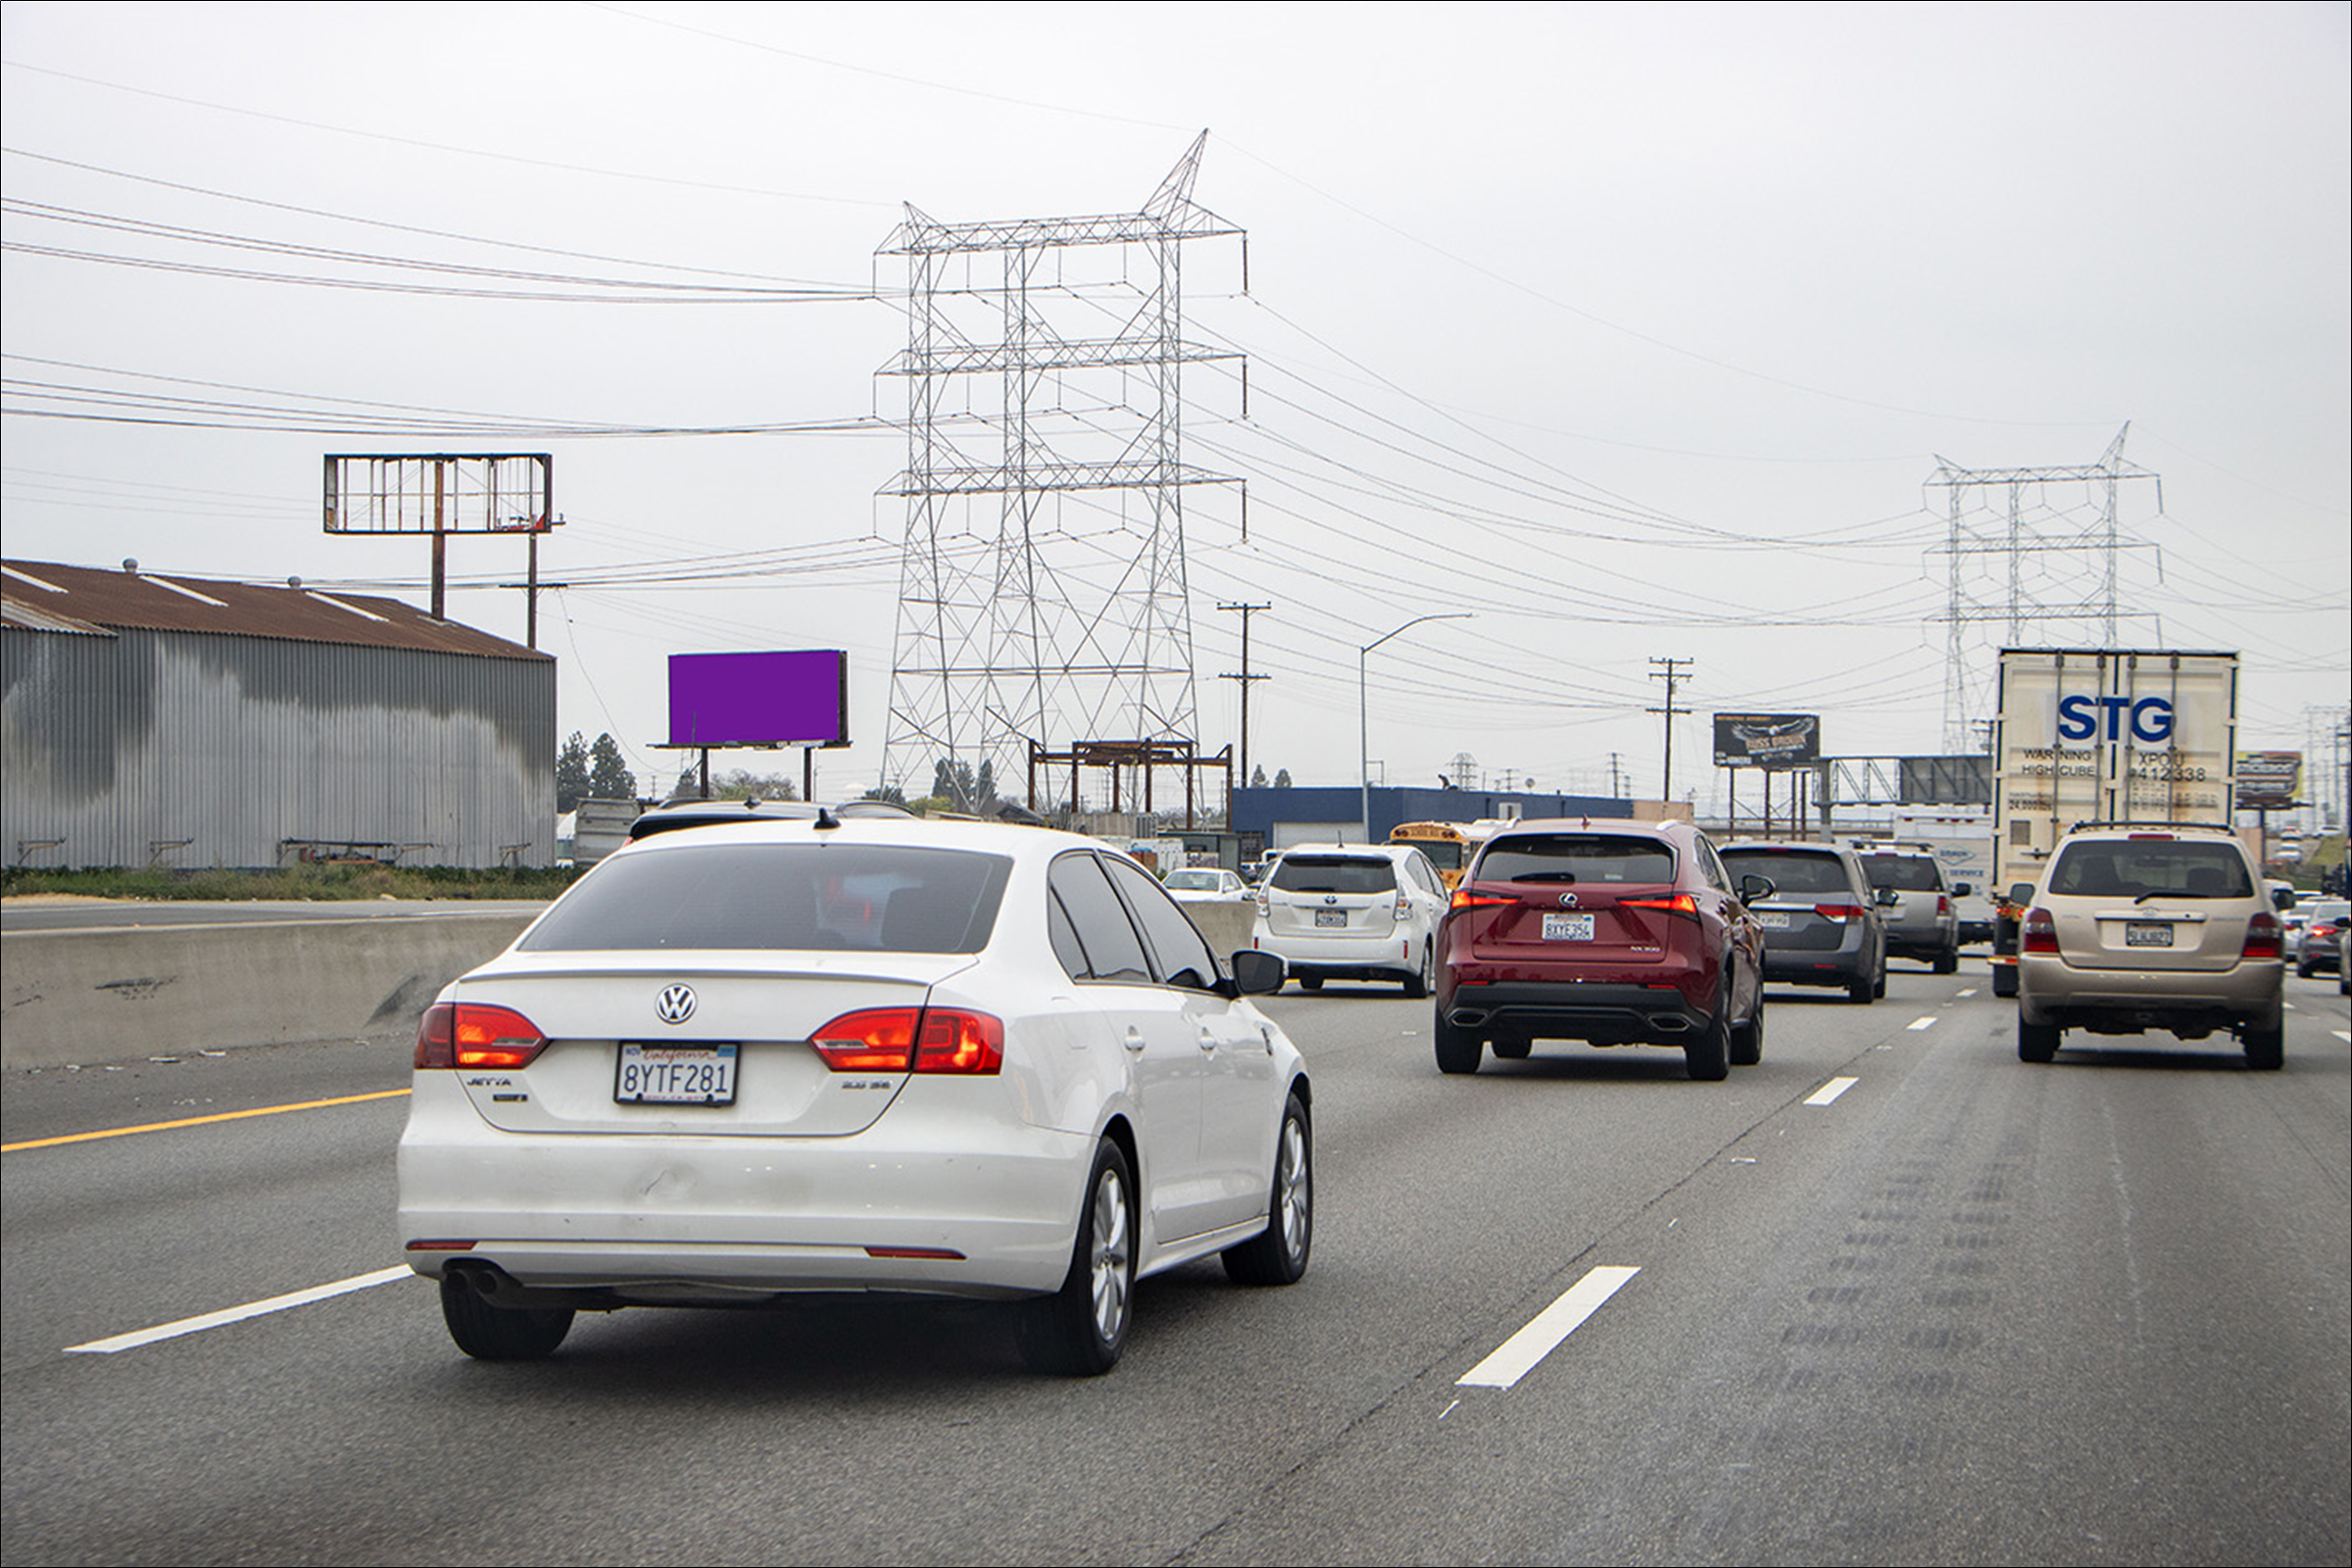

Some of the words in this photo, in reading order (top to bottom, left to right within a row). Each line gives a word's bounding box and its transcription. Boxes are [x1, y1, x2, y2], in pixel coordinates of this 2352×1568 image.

[2059, 695, 2177, 742] STG
[2023, 749, 2091, 760] WARNING
[2138, 752, 2184, 766] XPOU
[2022, 764, 2053, 775] HIGH
[2059, 765, 2096, 776] CUBE
[1545, 922, 1591, 937] 8XYE354
[467, 1077, 511, 1086] JETTA
[624, 1064, 727, 1093] 8YTF281
